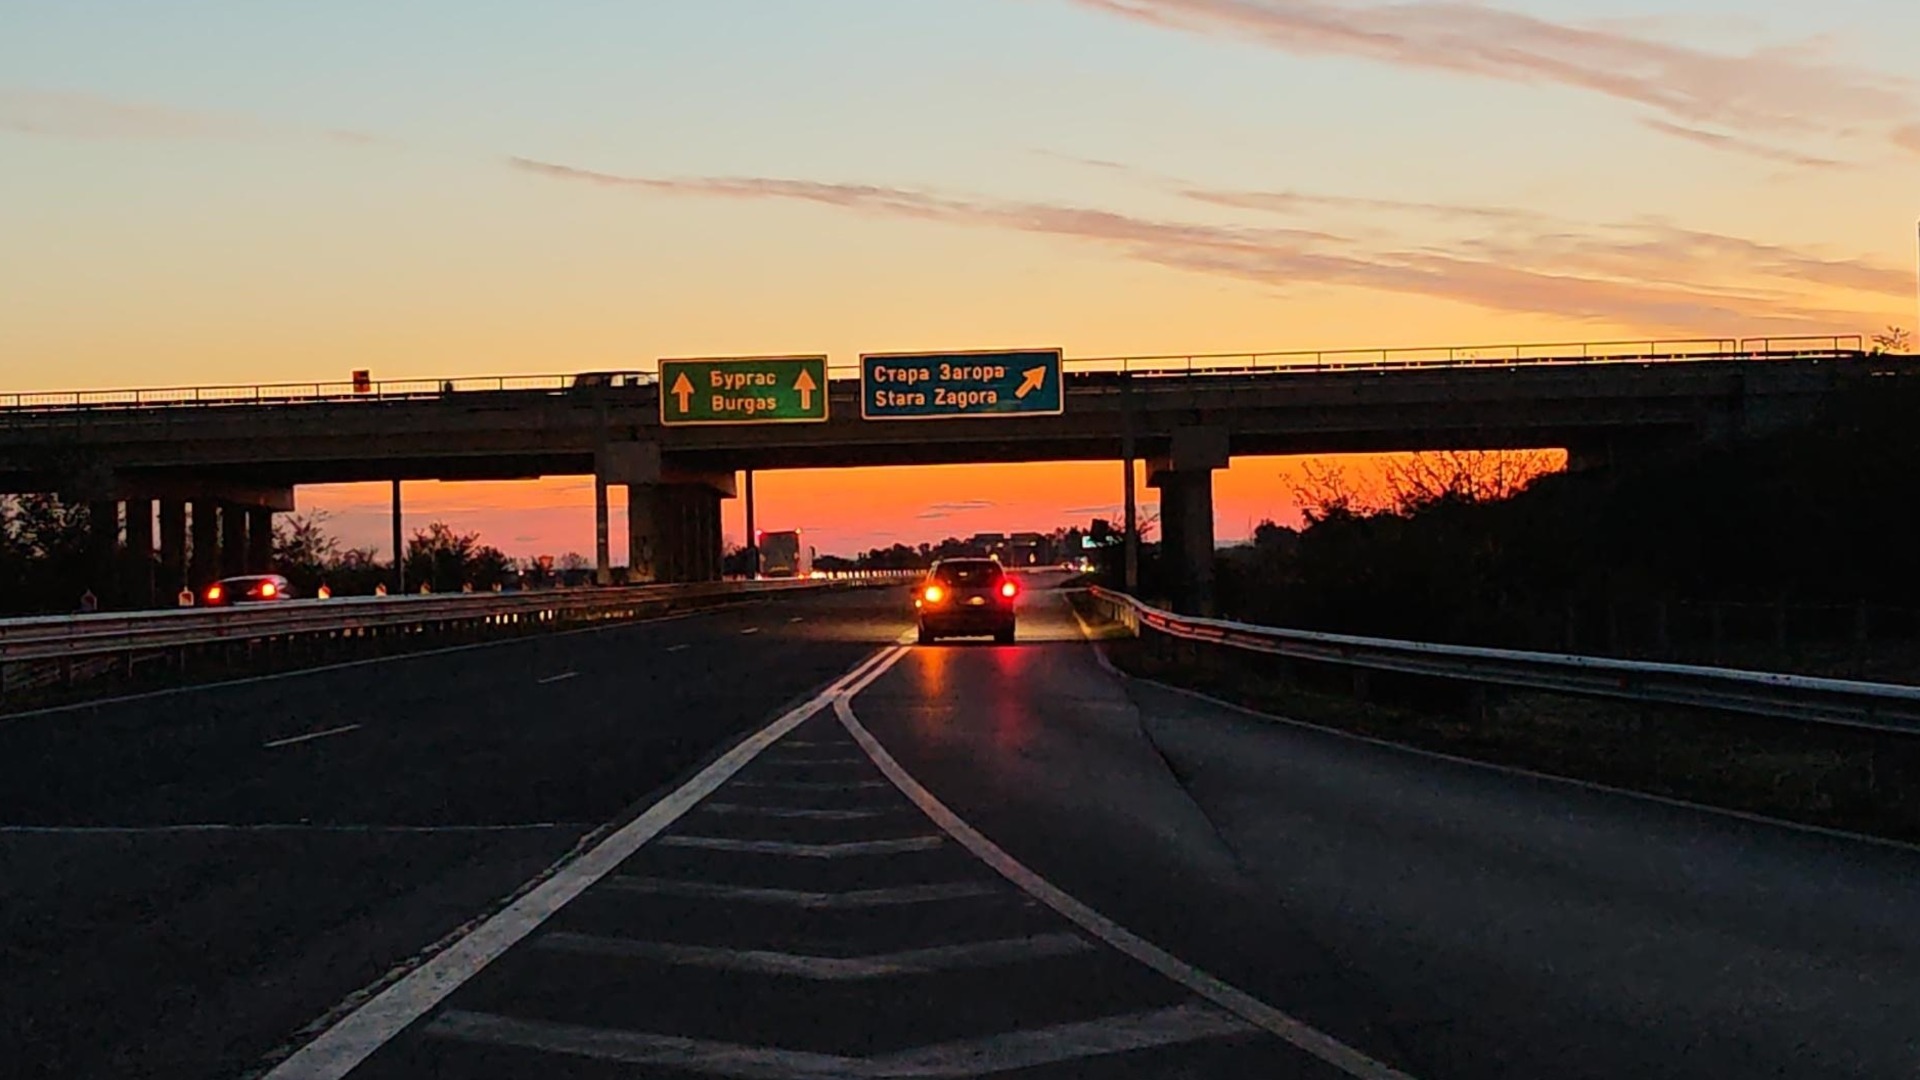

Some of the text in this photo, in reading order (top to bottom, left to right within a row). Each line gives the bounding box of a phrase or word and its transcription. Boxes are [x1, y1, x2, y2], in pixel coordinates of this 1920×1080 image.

[710, 370, 777, 390] Бургас
[874, 363, 1005, 385] Стара Загора
[712, 395, 777, 414] Burgas
[875, 388, 998, 409] Stara Zagora
